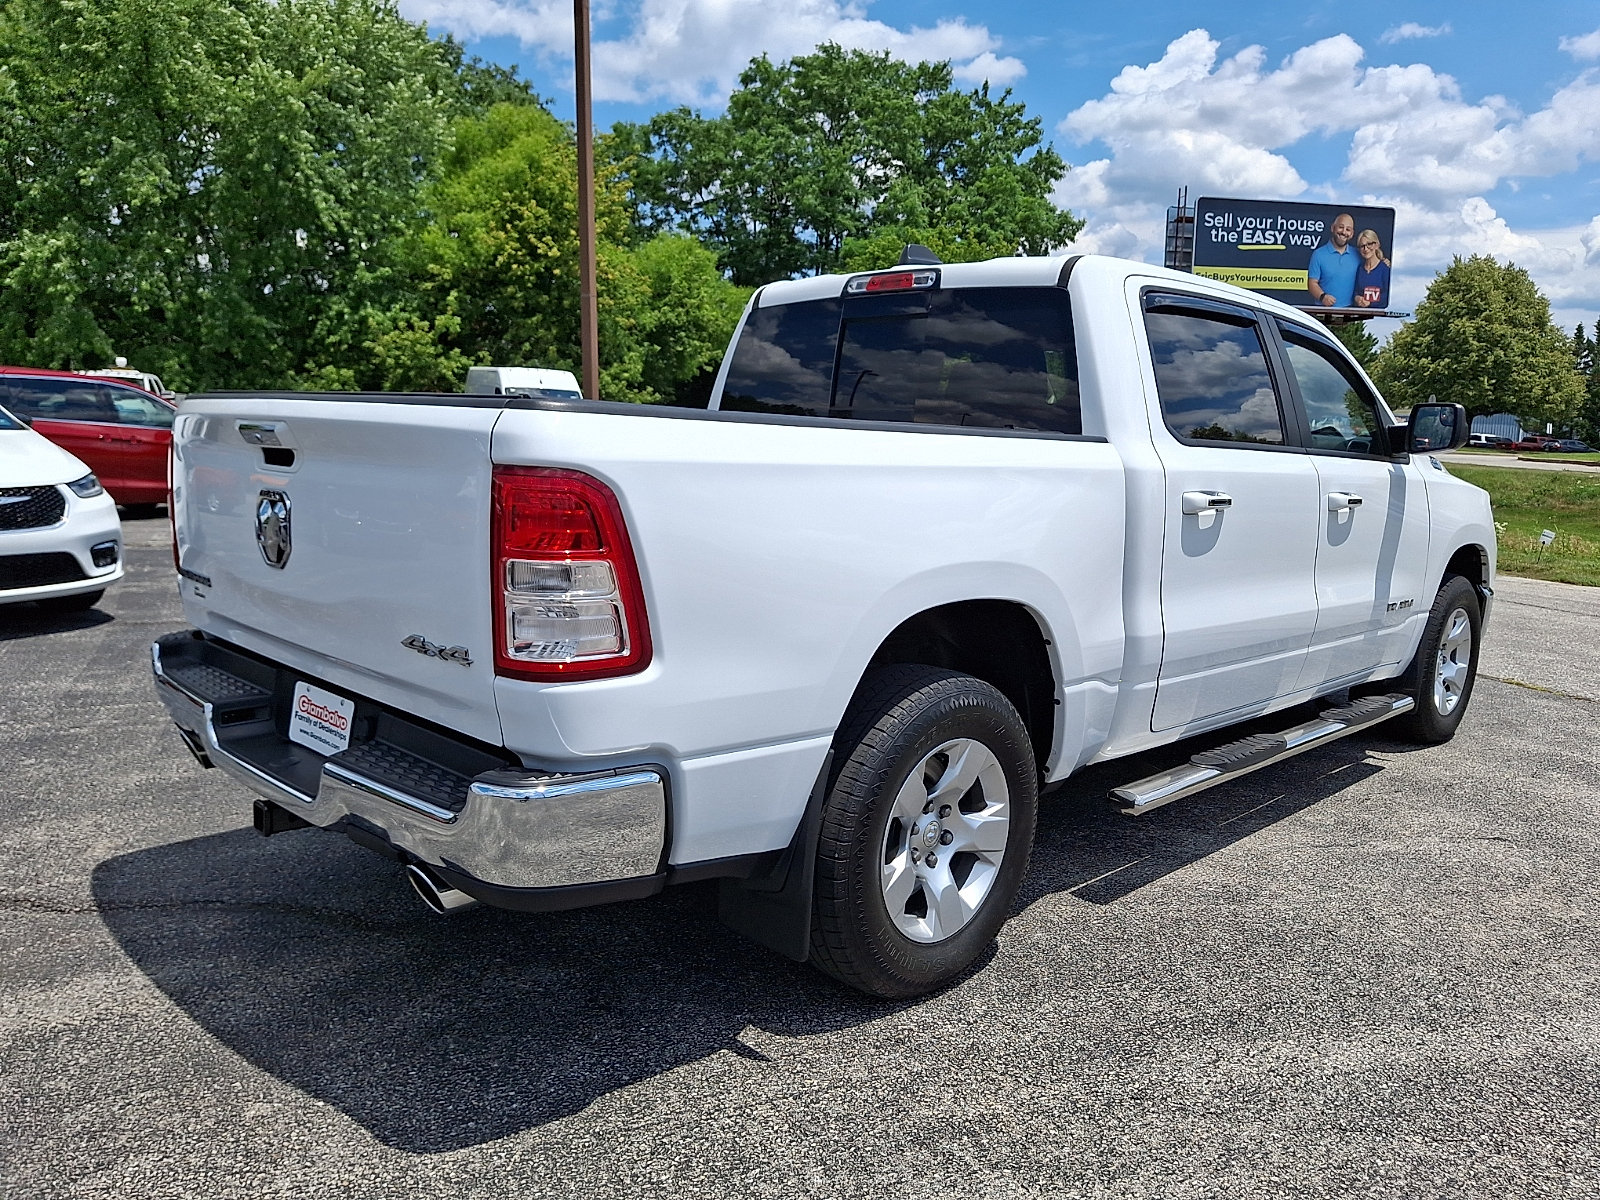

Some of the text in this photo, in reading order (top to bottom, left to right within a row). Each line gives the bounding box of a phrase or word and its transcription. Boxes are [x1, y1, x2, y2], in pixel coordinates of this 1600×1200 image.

[1204, 212, 1325, 232] Sell your house
[1211, 228, 1321, 250] the EASY way
[1365, 291, 1379, 300] TV
[299, 695, 347, 730] Giambalvo
[295, 710, 312, 725] Family
[319, 721, 347, 741] Dealerships
